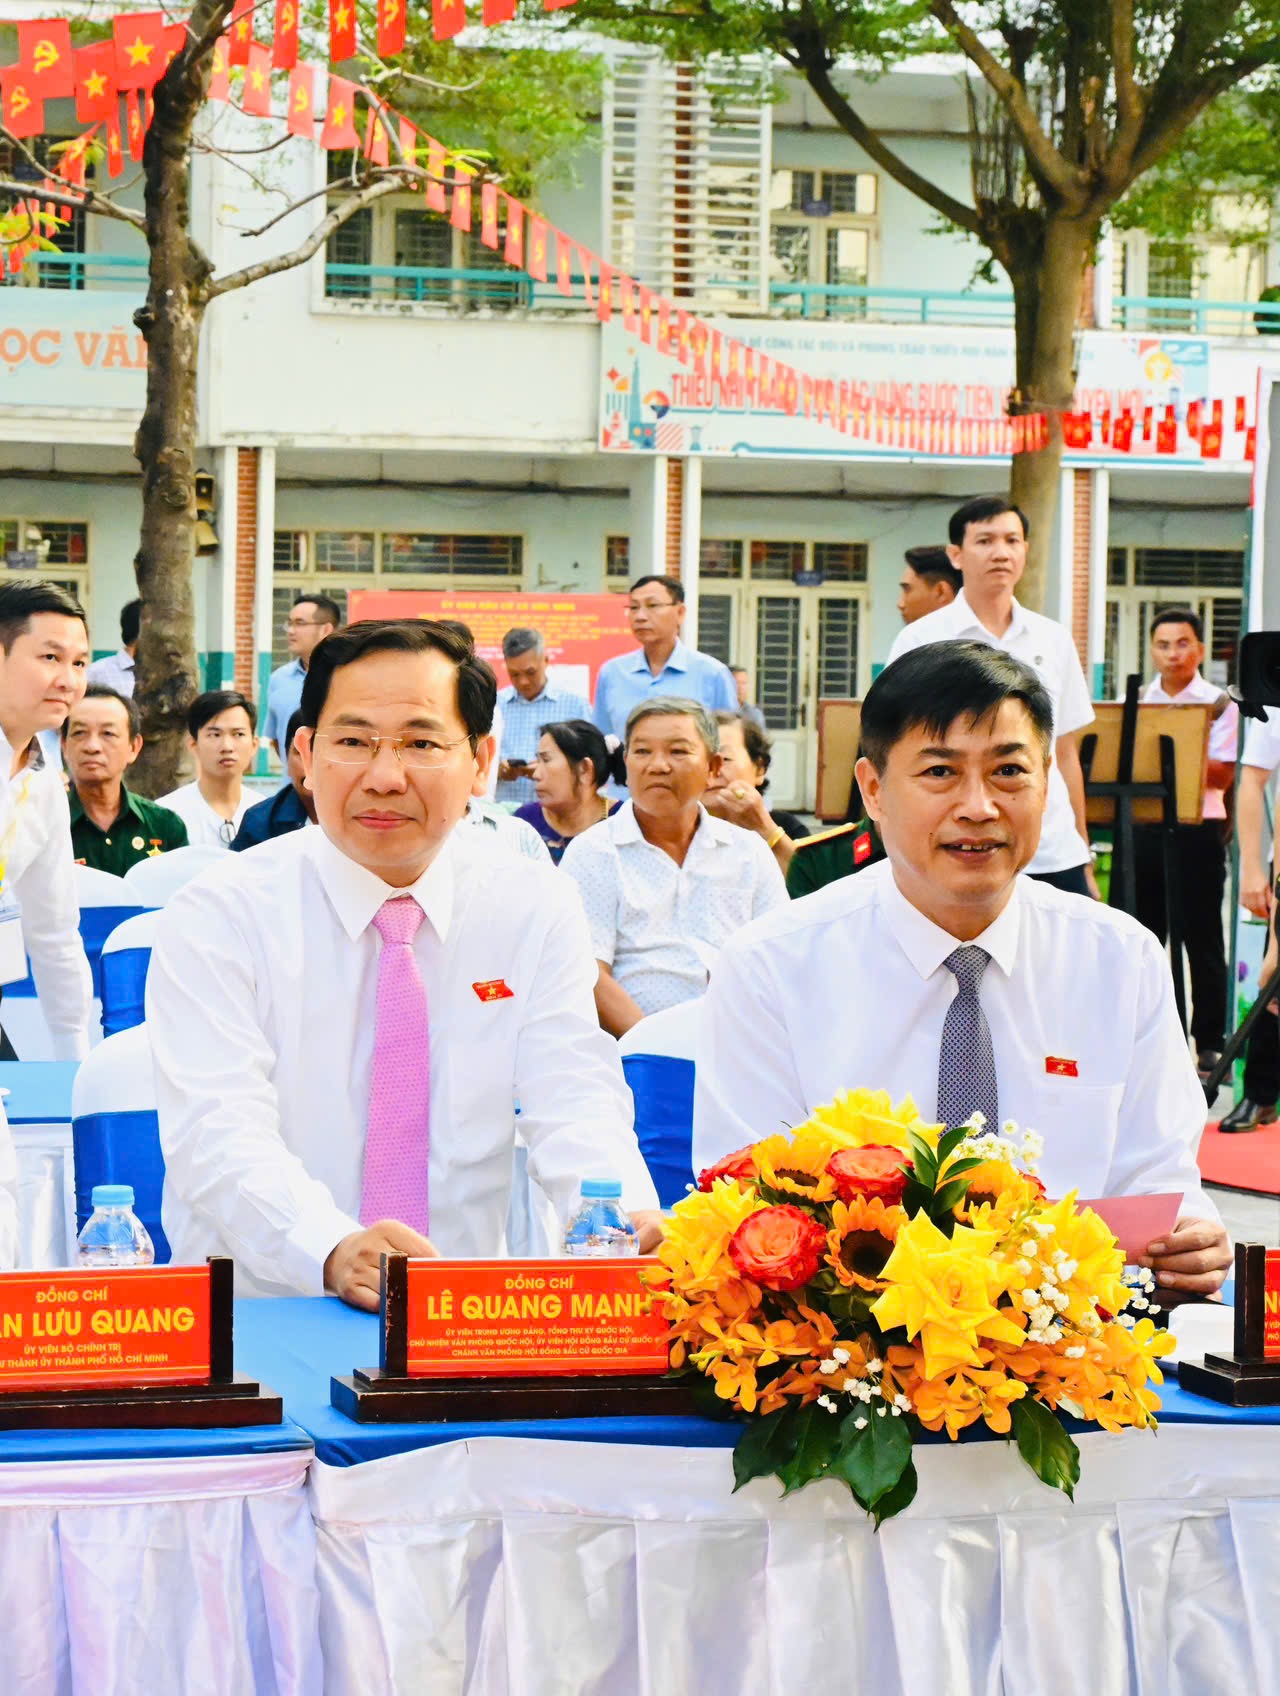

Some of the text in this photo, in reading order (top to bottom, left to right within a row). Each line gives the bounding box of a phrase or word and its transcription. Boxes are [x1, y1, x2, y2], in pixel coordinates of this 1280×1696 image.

[74, 325, 148, 368] VĂ
[505, 1273, 574, 1290] ĐỒNG CHÍ
[36, 1285, 108, 1303] ĐỒNG CHÍ
[427, 1289, 652, 1324] LÊ QUANG MẠNH
[32, 1309, 81, 1337] LƯU
[91, 1307, 195, 1335] QUANG
[38, 1343, 59, 1354] VIÊN
[61, 1343, 74, 1354] BỘ
[76, 1342, 107, 1353] CHÍNH
[87, 1354, 107, 1365] PHỐ
[125, 1354, 142, 1364] CHÍ
[143, 1353, 169, 1363] MINH
